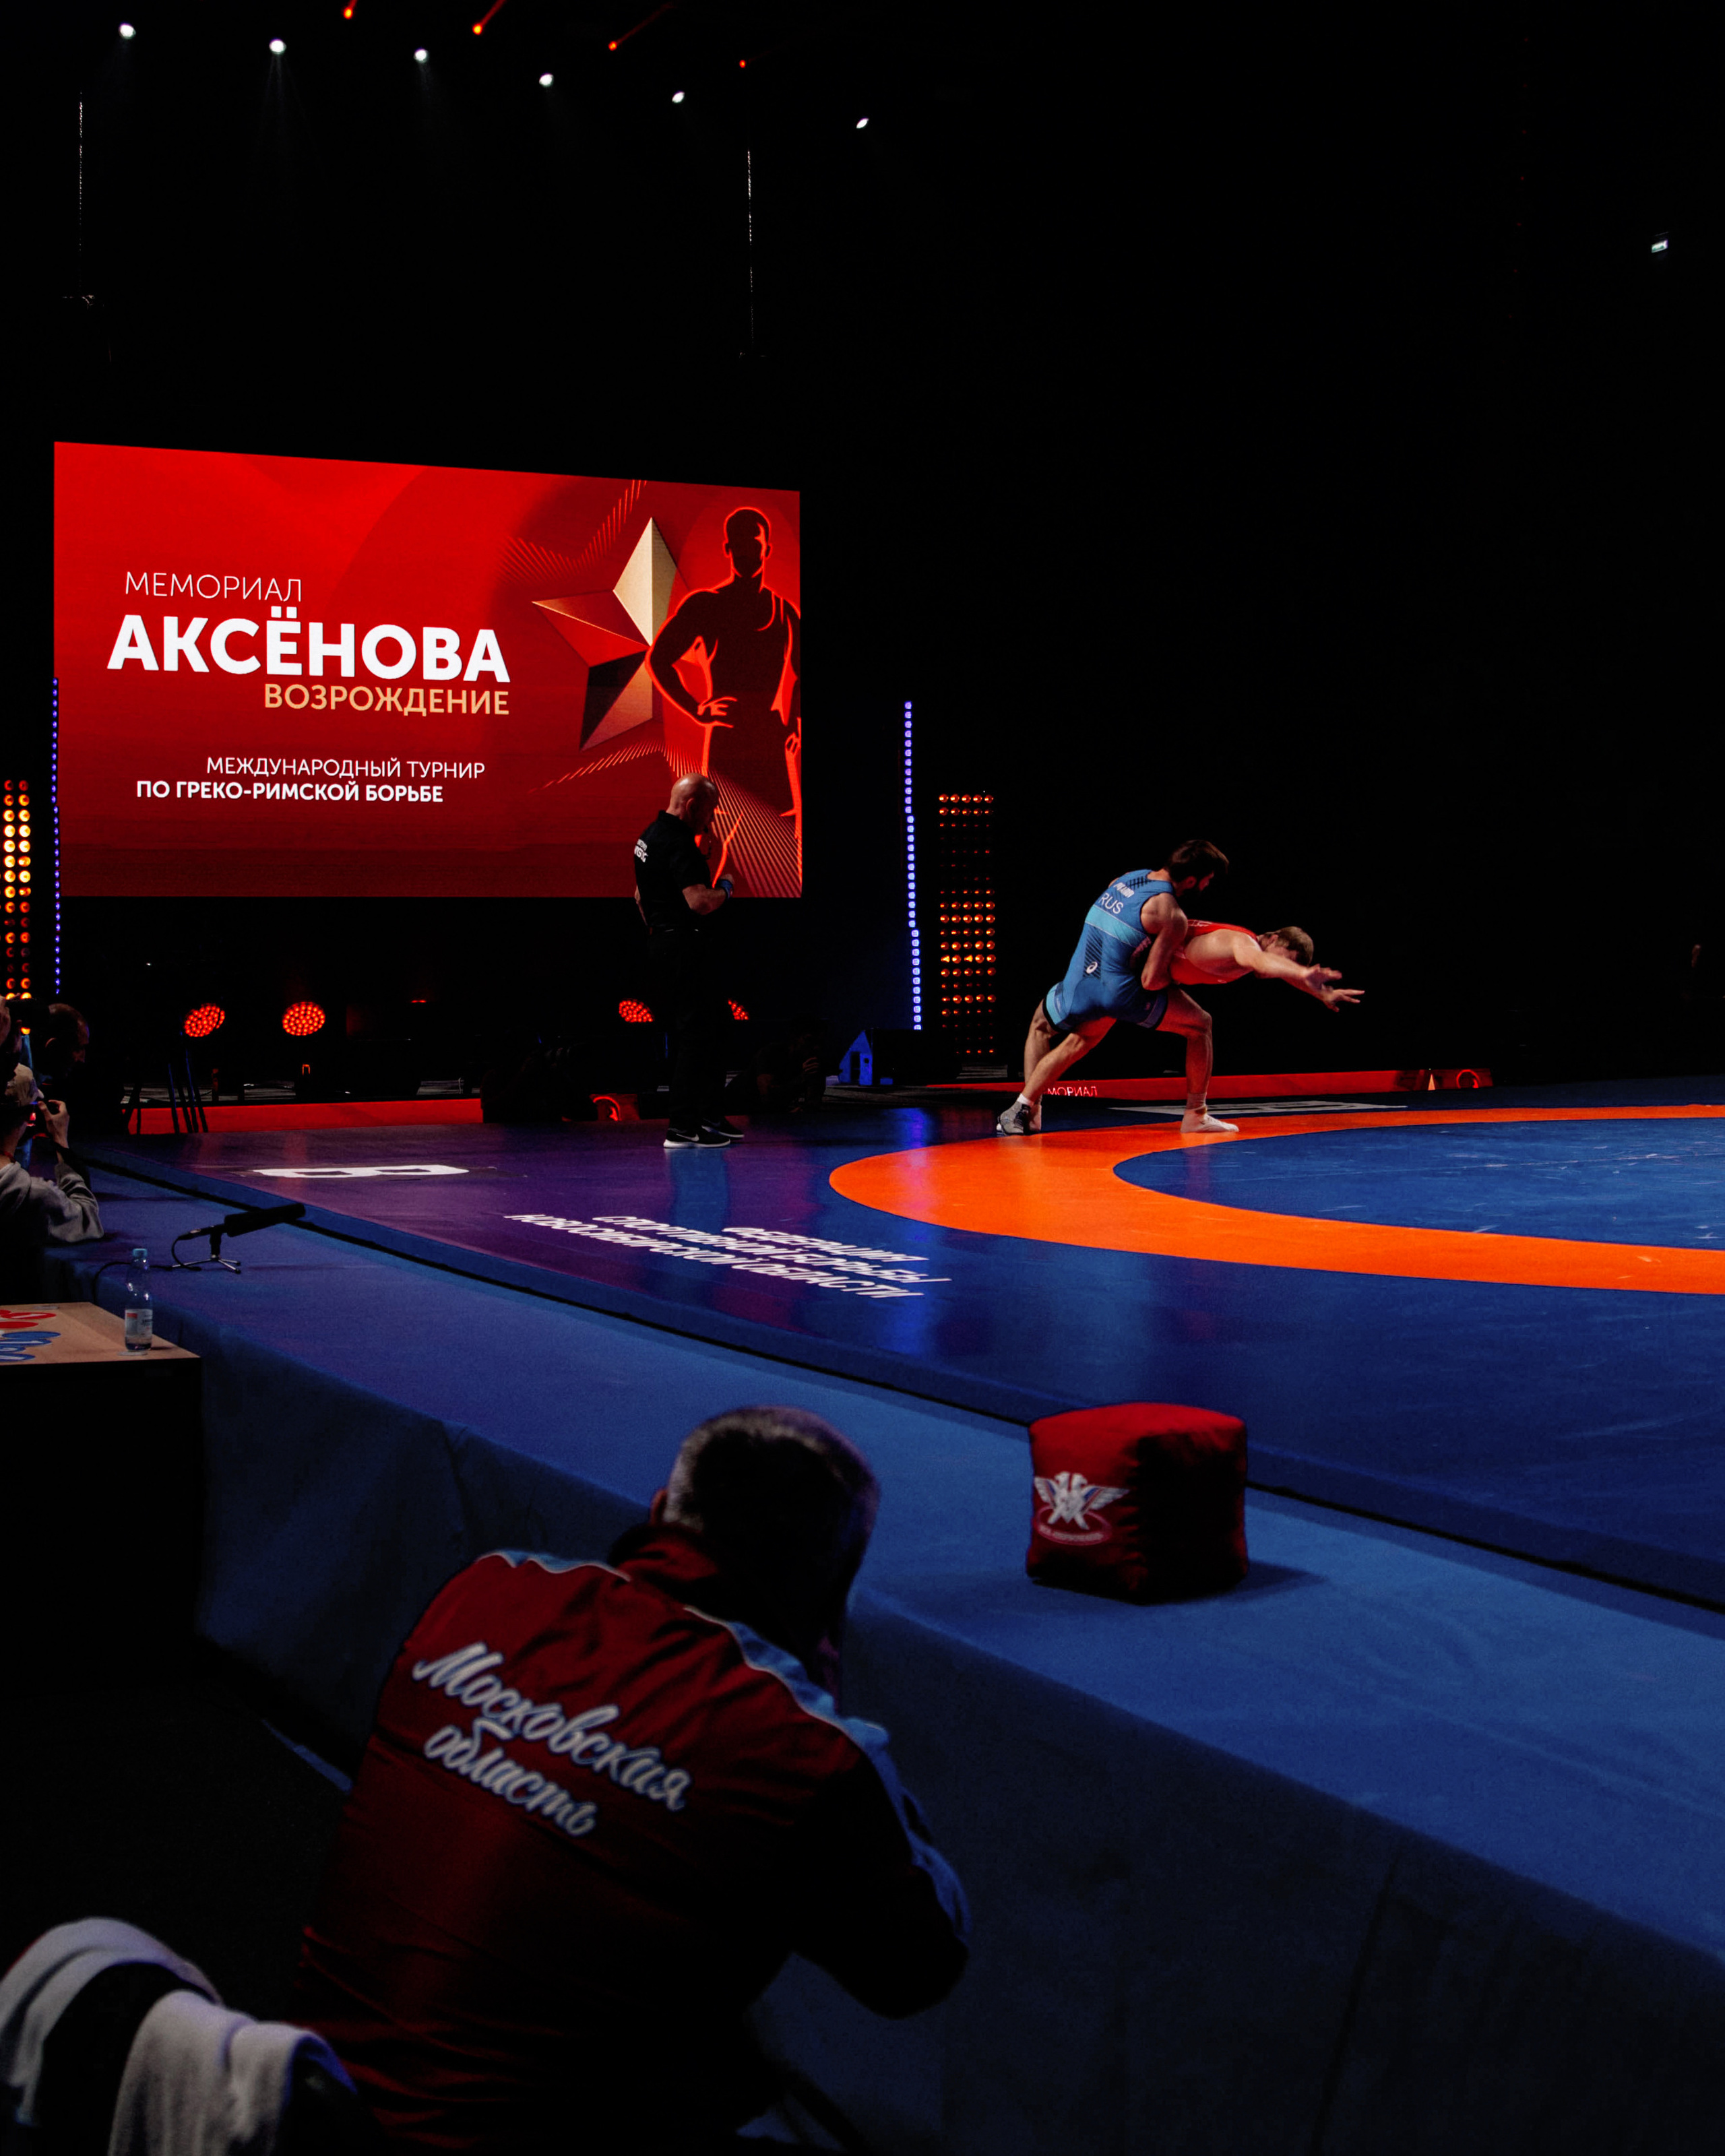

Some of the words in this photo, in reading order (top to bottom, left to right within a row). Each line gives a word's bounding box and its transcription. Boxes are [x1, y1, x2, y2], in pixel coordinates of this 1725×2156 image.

[125, 571, 302, 602] МЕМОРИАЛ
[106, 606, 511, 683] АКСЁНОВА
[264, 683, 509, 716] ВОЗРОЖДЕНИЕ
[206, 757, 401, 779] МЕЖДУНАРОДНЫЙ
[406, 761, 485, 779] ТУРНИР
[137, 780, 170, 798] ПО
[176, 781, 359, 800] ГРЕКО-РИМСКОЙ
[366, 784, 443, 802] БОРЬБЕ
[1098, 893, 1124, 914] RUS
[1047, 1085, 1098, 1097] МОРИАЛ
[503, 1214, 770, 1265] НОВОСИБИРСКОЙ
[731, 1263, 924, 1298] ОБЛАСТИ
[592, 1216, 809, 1255] СПОРТИВНОЙ
[767, 1253, 952, 1283] БОРЬБЫ
[722, 1227, 929, 1262] ФЕДЕРАЦИЯ
[412, 1641, 691, 1811] Московская
[424, 1716, 597, 1837] область
